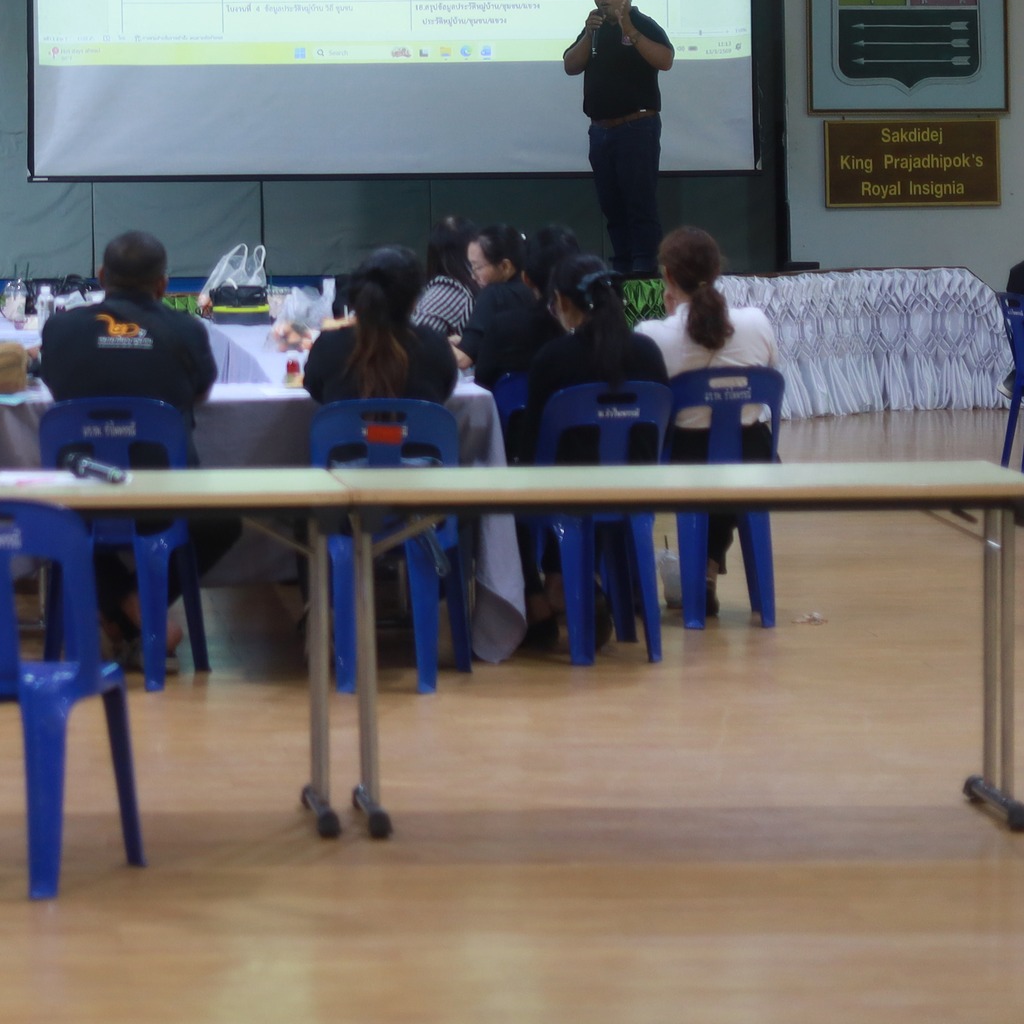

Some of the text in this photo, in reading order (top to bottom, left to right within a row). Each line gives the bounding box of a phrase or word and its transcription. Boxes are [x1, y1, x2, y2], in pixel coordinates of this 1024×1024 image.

[881, 127, 943, 144] Sakdidej
[840, 153, 984, 173] King Prajadhipok's
[861, 180, 965, 199] Royal Insignia
